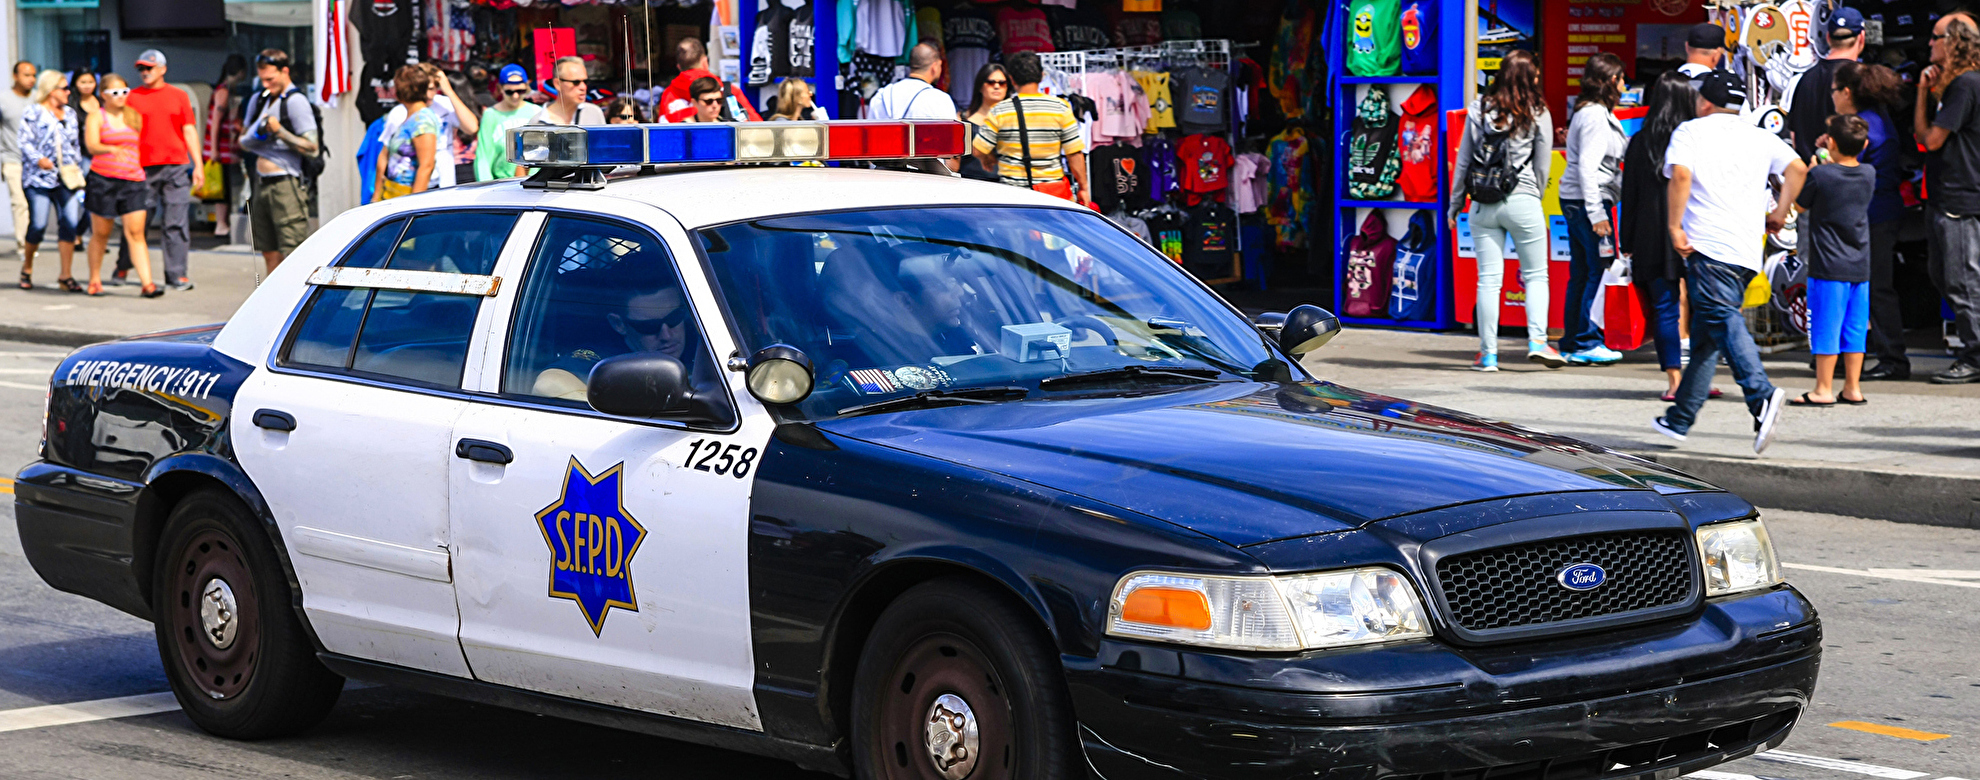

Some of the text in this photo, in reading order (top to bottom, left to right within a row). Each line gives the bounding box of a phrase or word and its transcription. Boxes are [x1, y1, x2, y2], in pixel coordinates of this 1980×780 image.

[684, 438, 758, 479] 1258
[556, 510, 624, 580] S.F.P.D.
[1571, 568, 1597, 585] Ford
